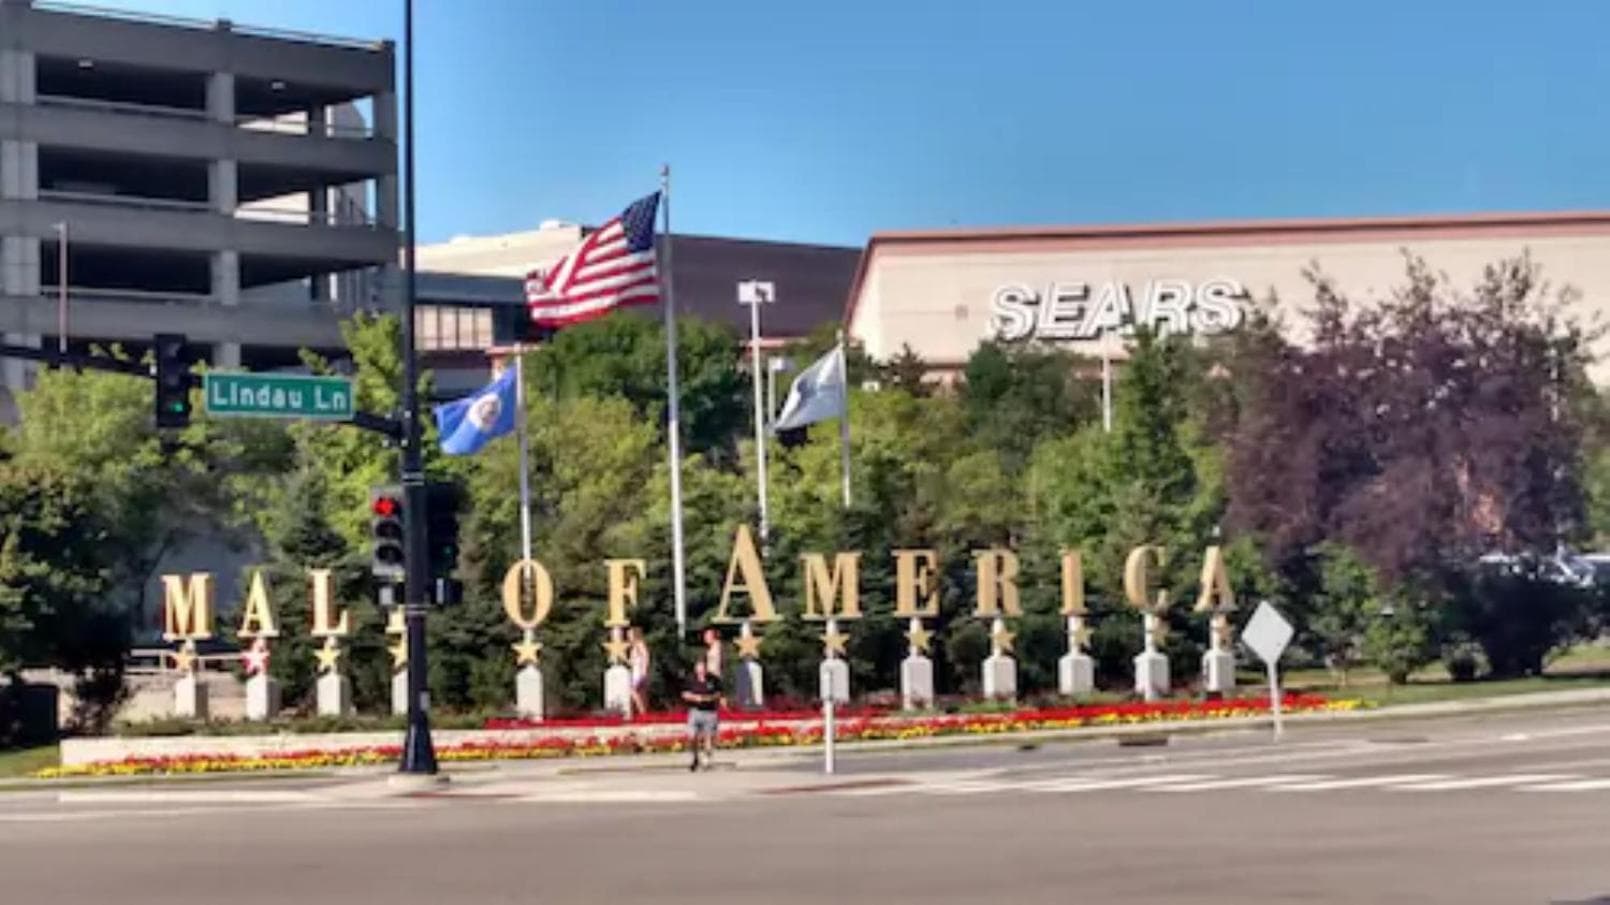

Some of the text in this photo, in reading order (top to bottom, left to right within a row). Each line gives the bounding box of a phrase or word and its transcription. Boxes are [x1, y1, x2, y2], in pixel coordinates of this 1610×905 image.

[991, 274, 1247, 341] SEARS
[213, 382, 346, 411] Lindau Ln
[161, 566, 408, 641] MAL
[502, 557, 645, 629] OF
